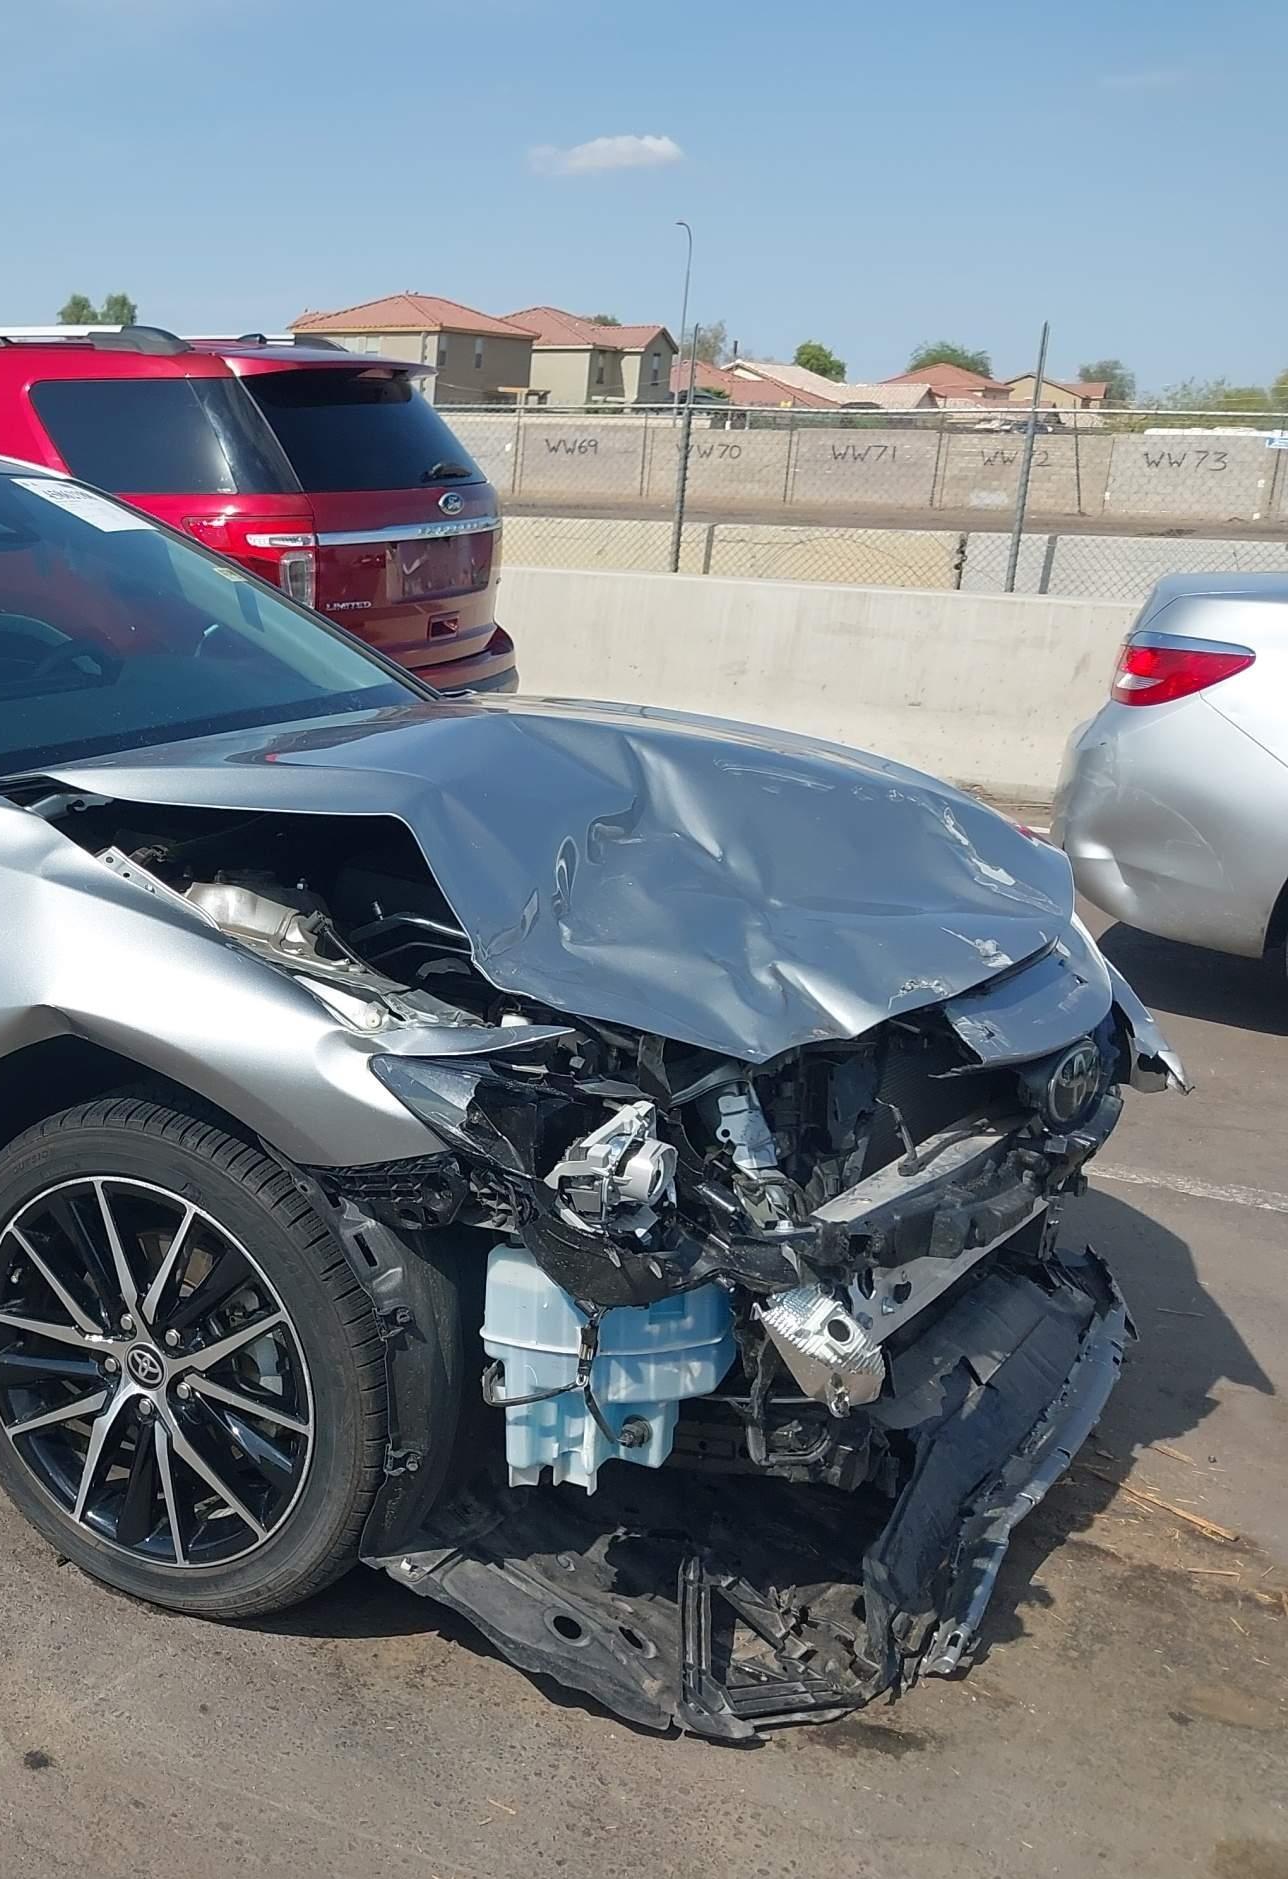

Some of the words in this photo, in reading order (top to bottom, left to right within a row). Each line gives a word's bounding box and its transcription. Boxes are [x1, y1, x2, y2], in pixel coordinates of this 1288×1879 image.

[544, 438, 599, 456] WW69
[831, 444, 897, 462] WW71
[980, 449, 1052, 467] WW2
[325, 600, 372, 612] LIMITED
